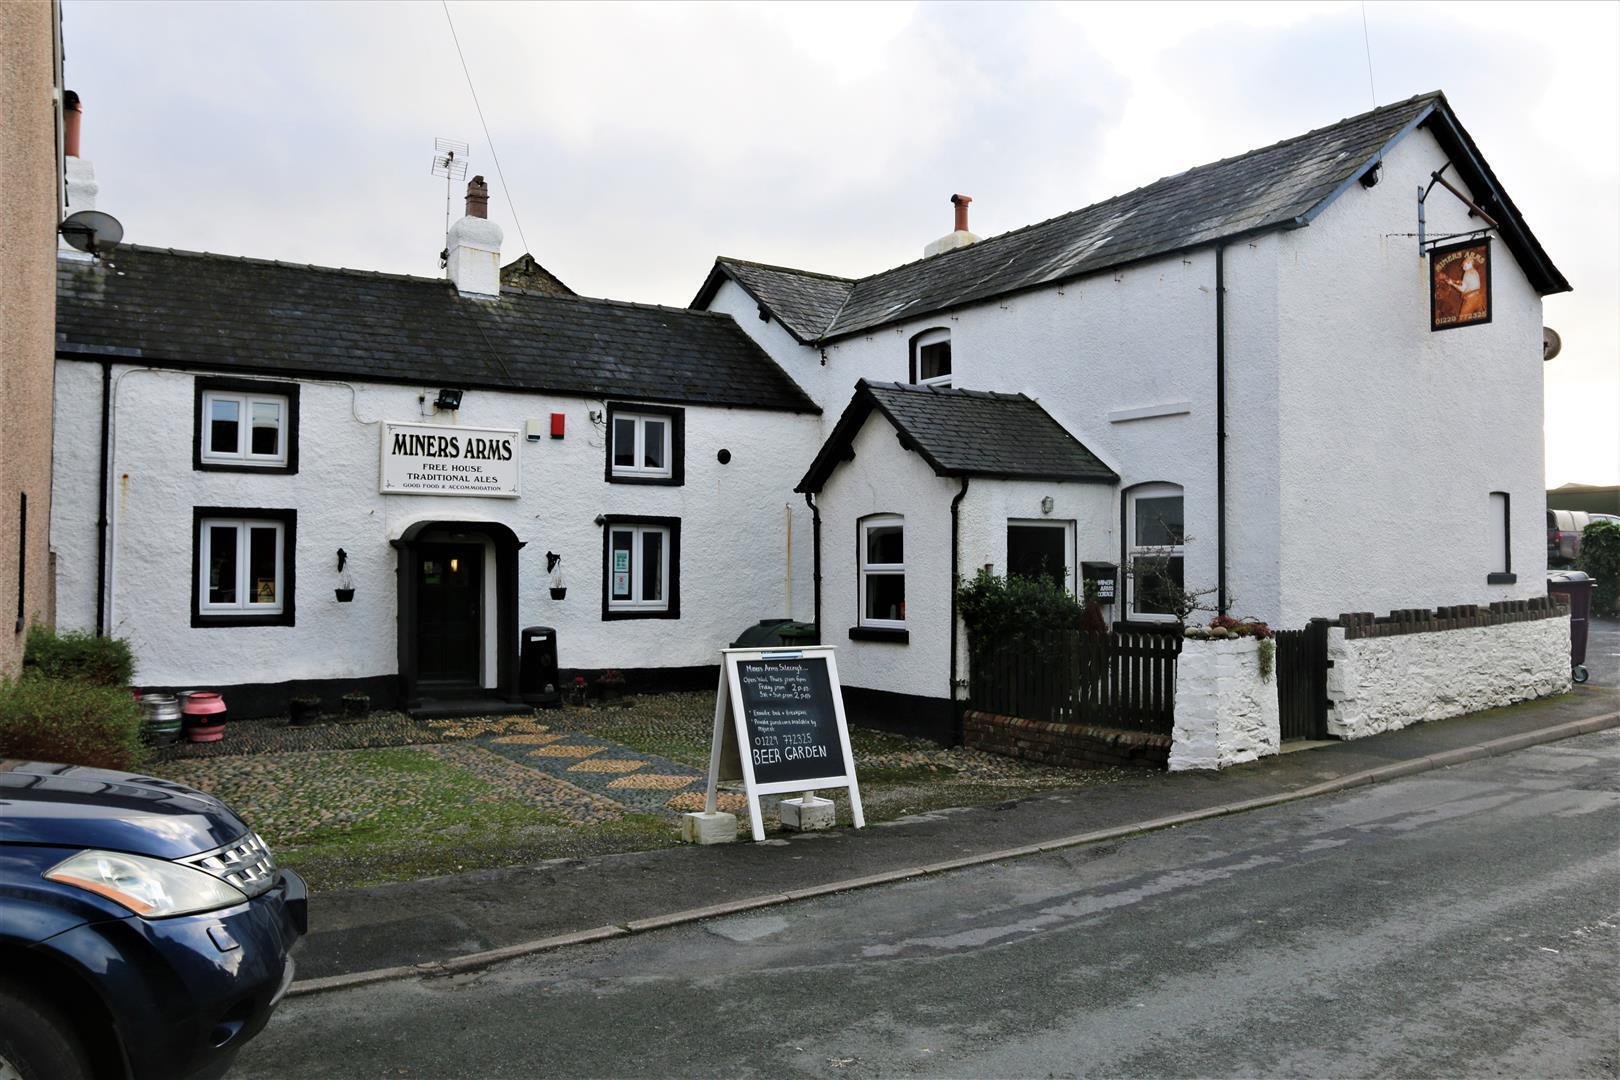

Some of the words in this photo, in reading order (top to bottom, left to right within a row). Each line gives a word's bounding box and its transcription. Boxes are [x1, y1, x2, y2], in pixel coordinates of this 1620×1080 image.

[1464, 252, 1485, 264] ARMS
[392, 433, 460, 459] MINERS
[464, 438, 513, 461] ARMS
[422, 463, 448, 472] FREE
[451, 464, 483, 473] HOUSE
[407, 473, 471, 483] TRADITIONAL
[473, 476, 498, 484] ALES
[759, 683, 773, 691] Friday
[755, 736, 779, 746] 01229
[753, 748, 782, 765] BEER
[784, 745, 827, 760] GARDEN
